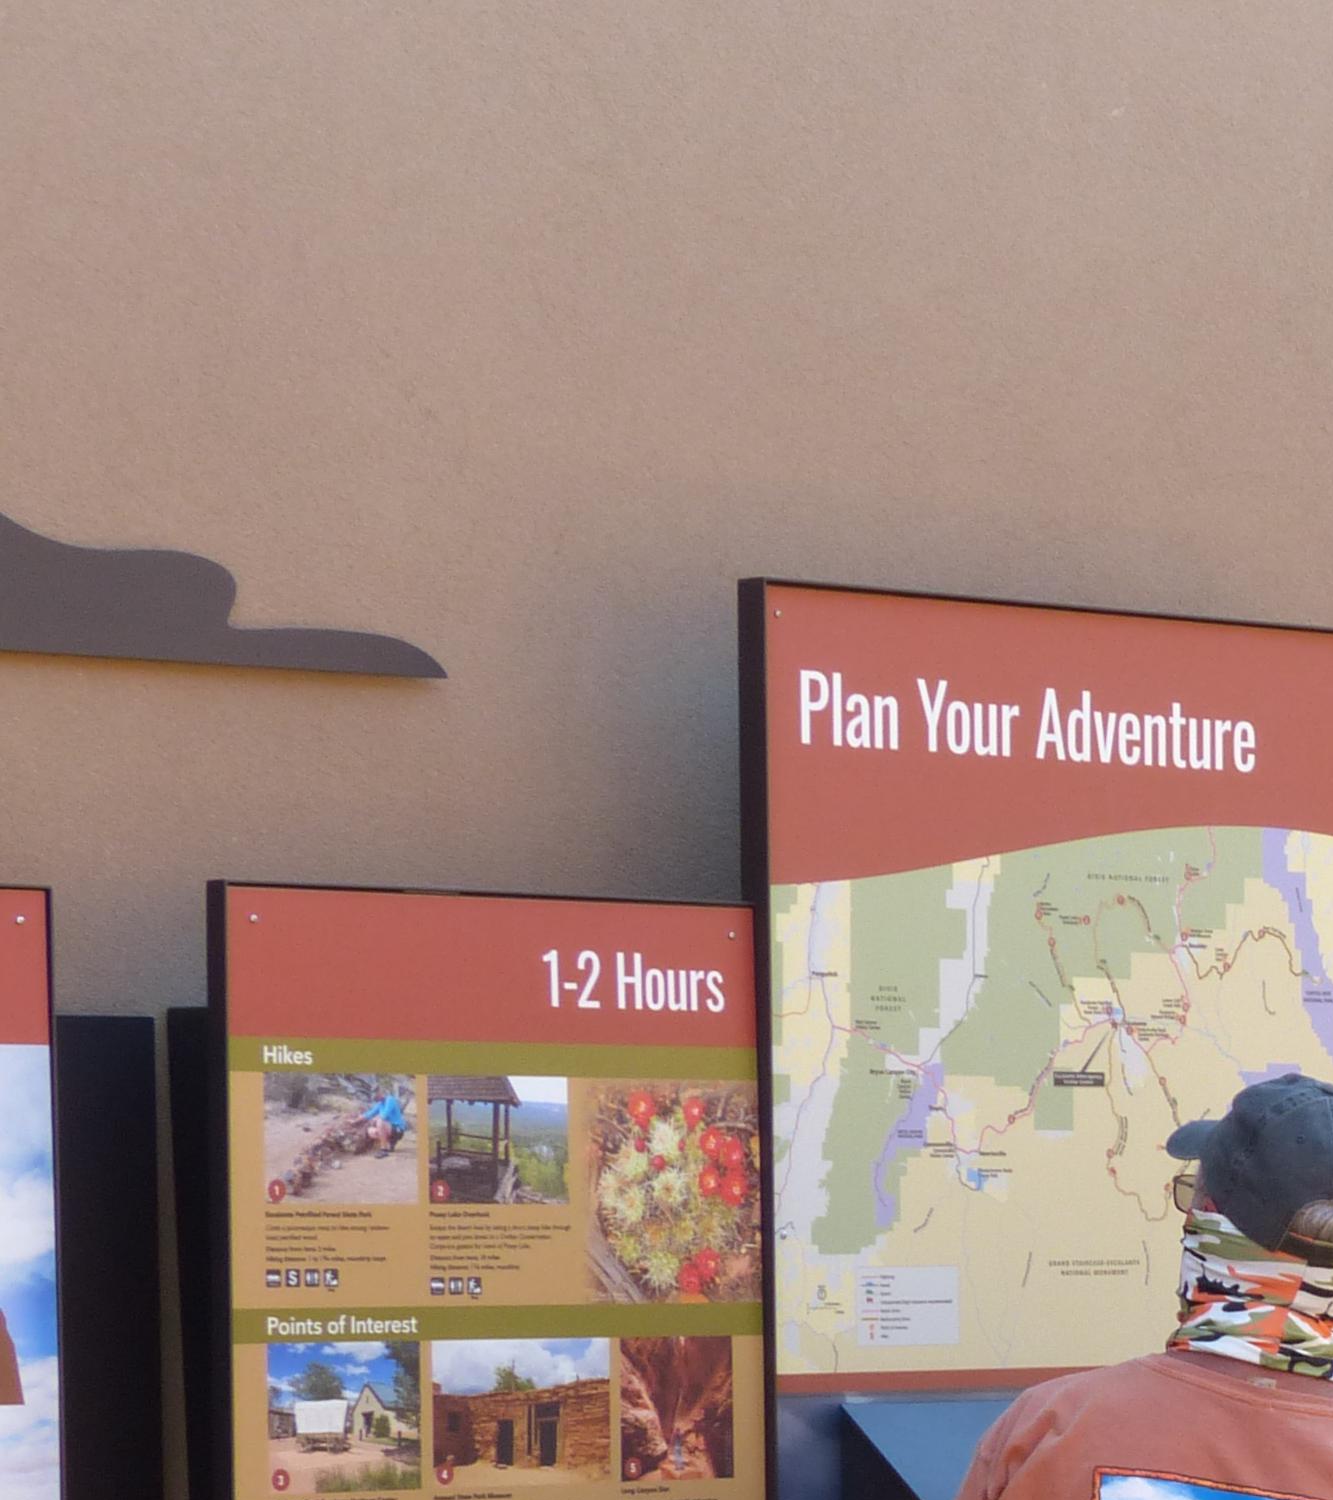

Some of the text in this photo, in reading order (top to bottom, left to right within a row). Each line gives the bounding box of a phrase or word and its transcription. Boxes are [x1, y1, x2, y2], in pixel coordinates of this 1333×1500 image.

[799, 669, 1256, 772] Plan Your Adventure
[542, 949, 724, 1013] 1-2 Hours
[263, 1045, 313, 1066] Hikes
[266, 1315, 417, 1337] Points of Interest
